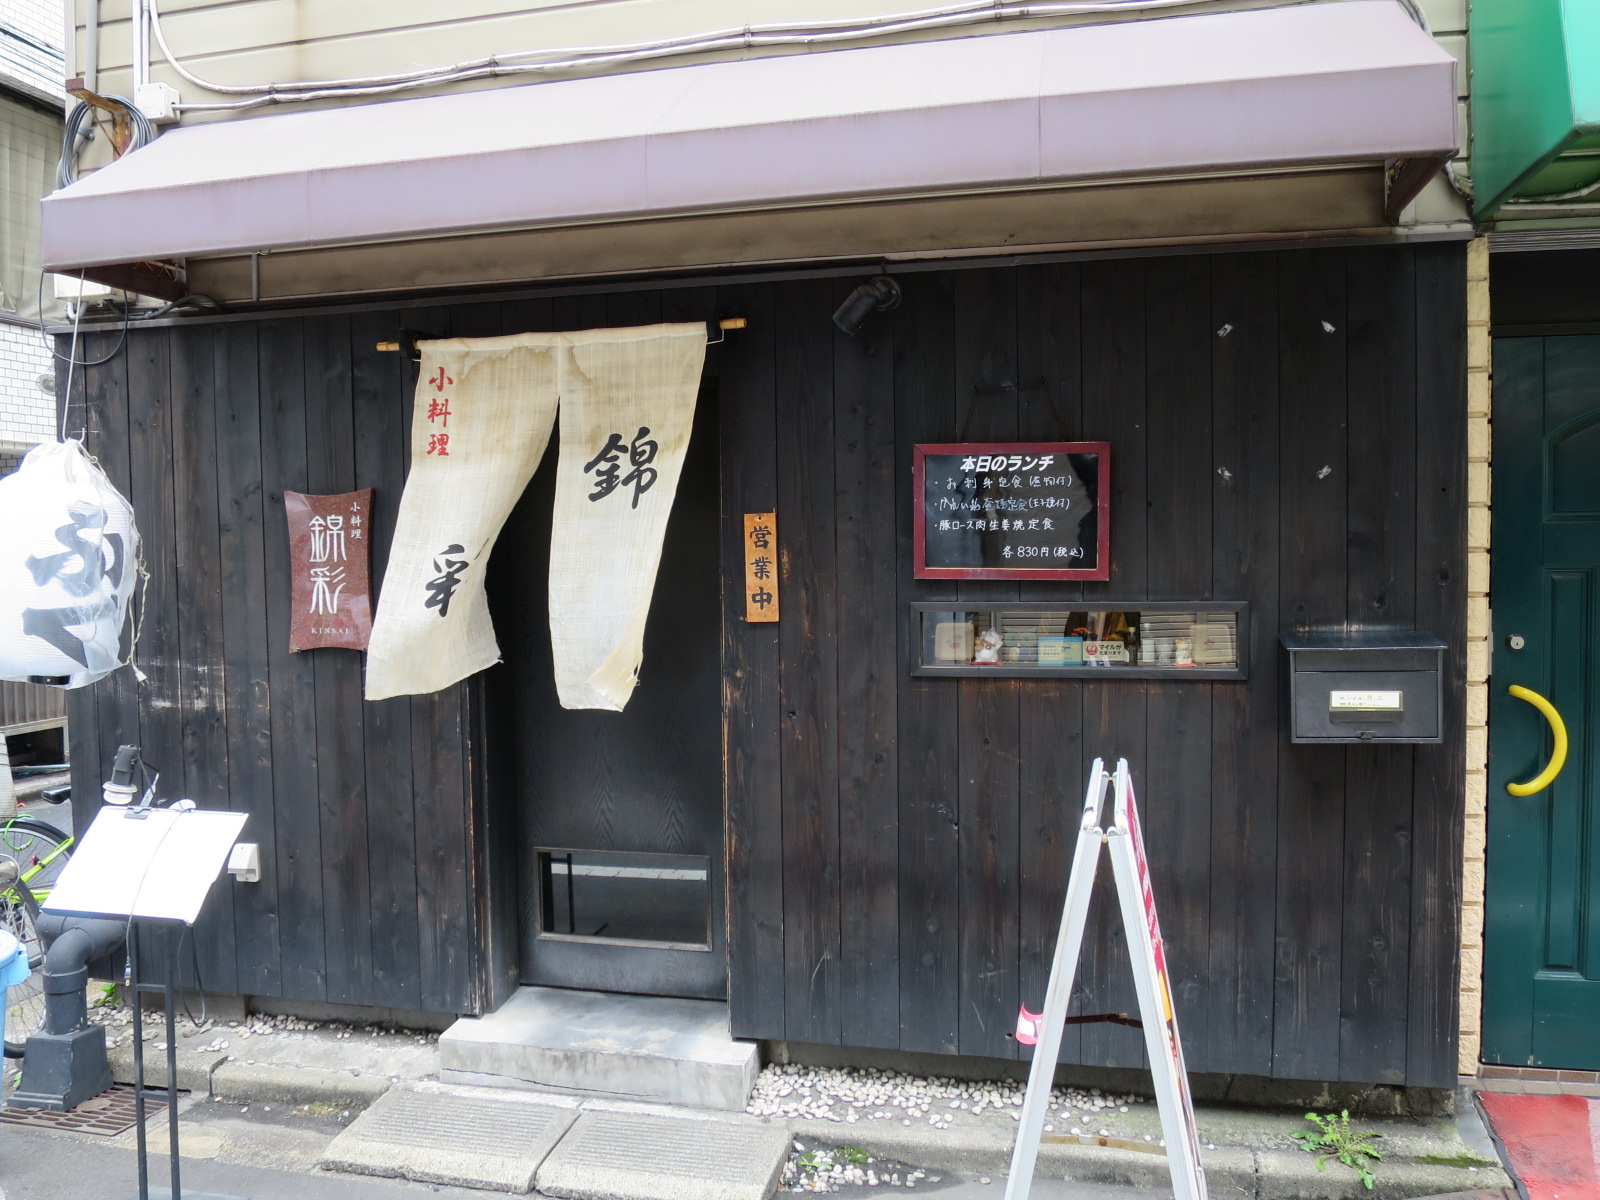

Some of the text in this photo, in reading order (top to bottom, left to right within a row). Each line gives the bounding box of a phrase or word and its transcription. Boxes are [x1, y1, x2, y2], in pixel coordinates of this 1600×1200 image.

[427, 366, 453, 457] 小料理
[583, 426, 659, 510] 錦
[960, 455, 1054, 473] 本日のランチ
[350, 501, 362, 539] 小料理
[309, 514, 347, 615] 錦彩
[749, 525, 772, 610] 営業中
[311, 627, 350, 635] KINSAI
